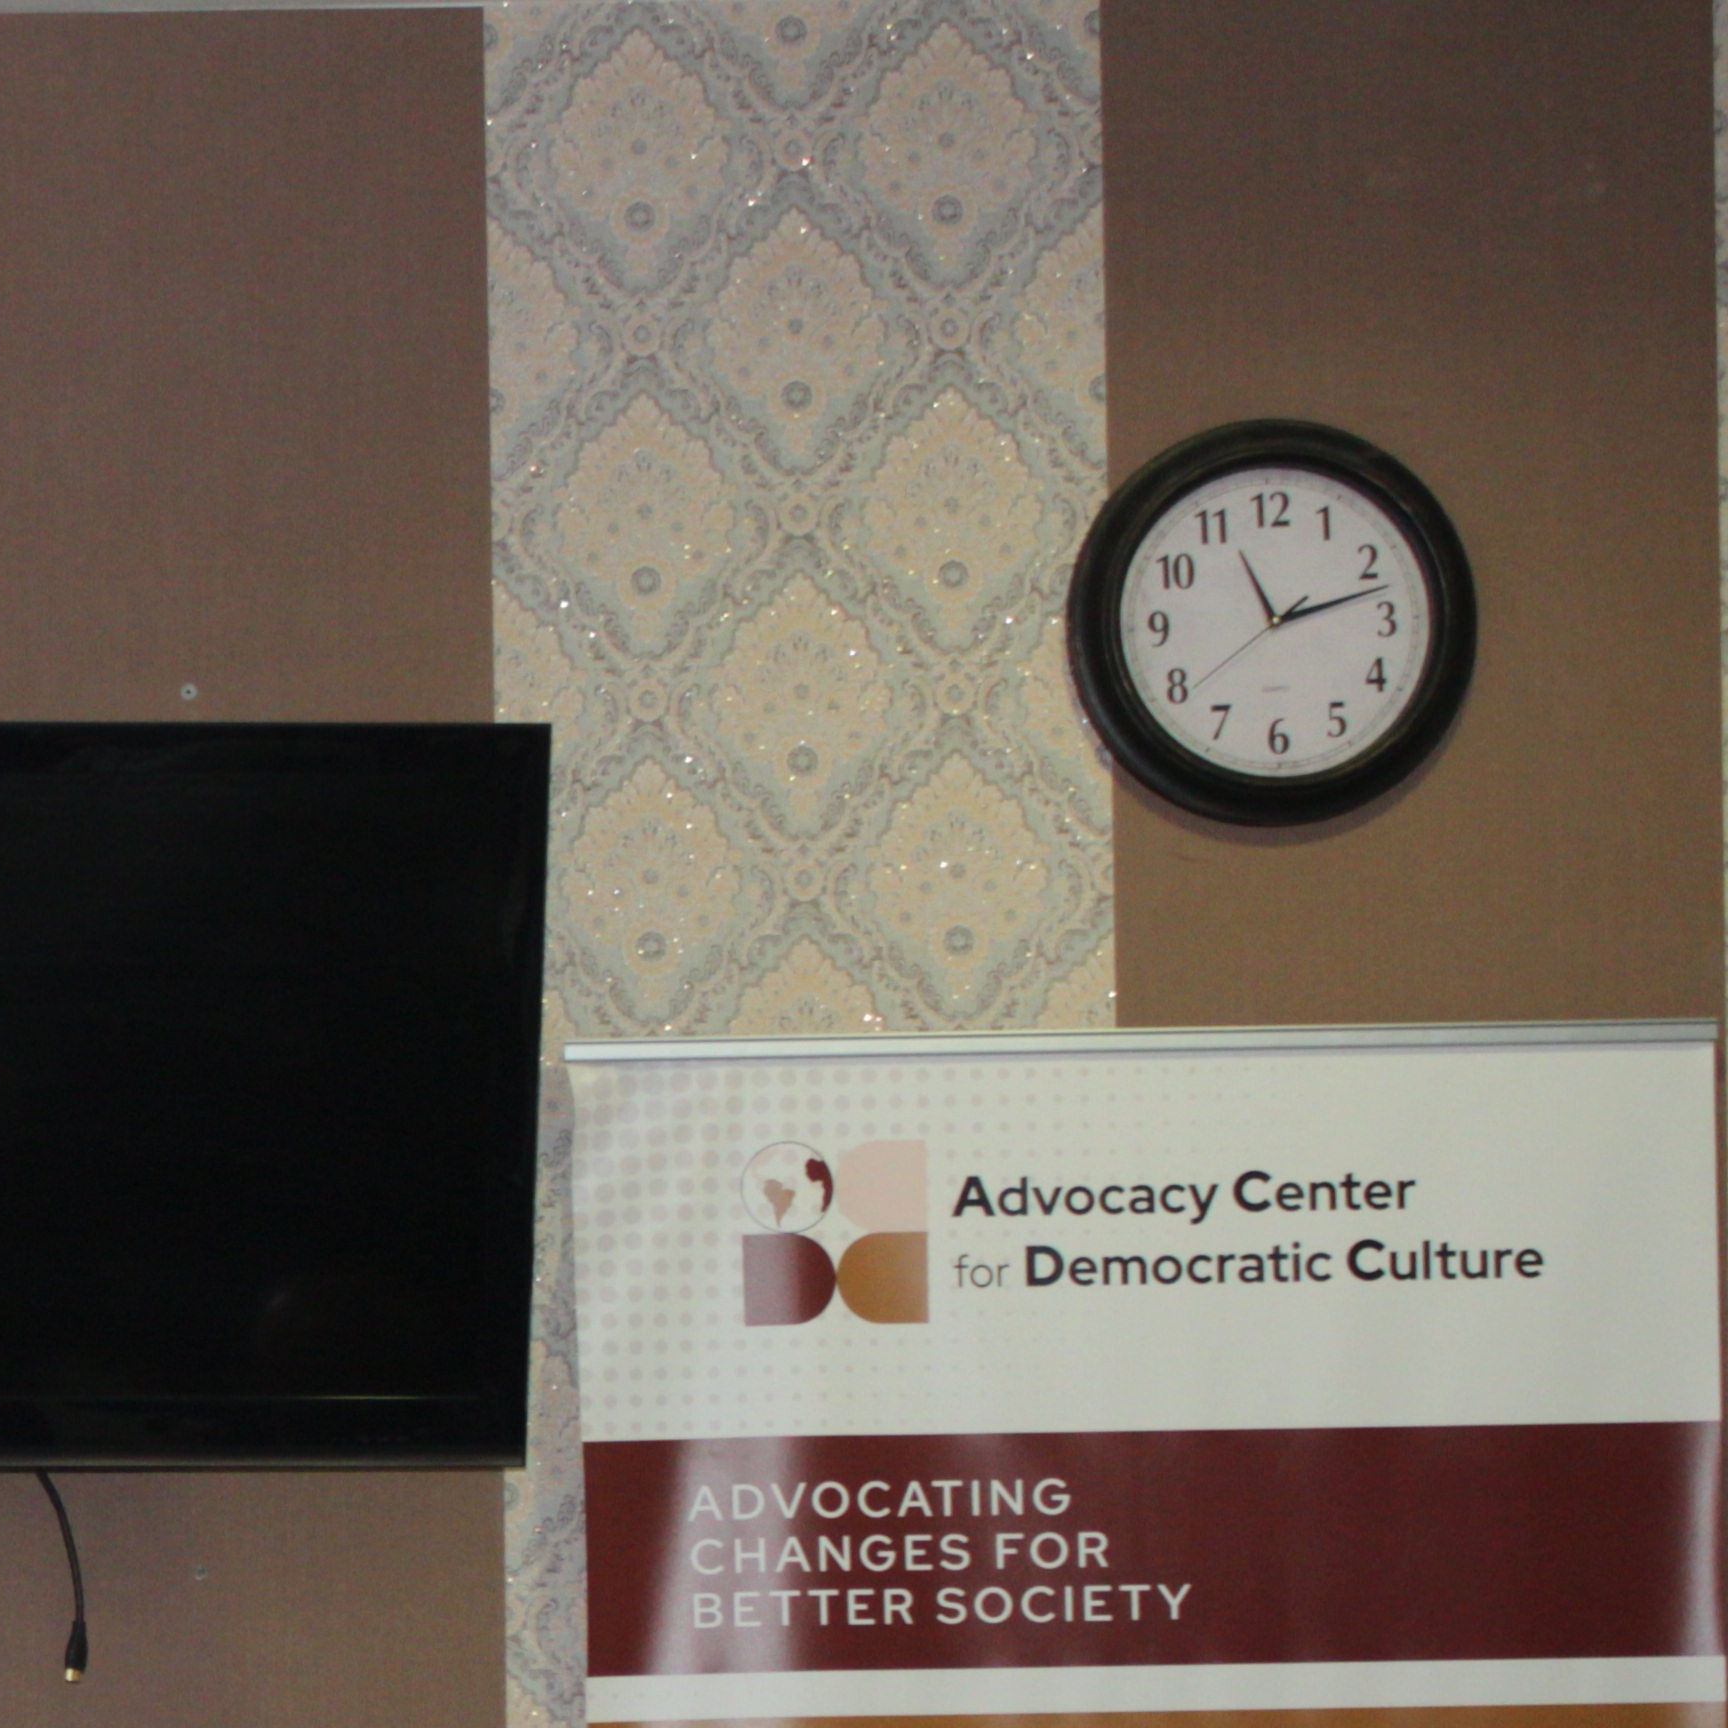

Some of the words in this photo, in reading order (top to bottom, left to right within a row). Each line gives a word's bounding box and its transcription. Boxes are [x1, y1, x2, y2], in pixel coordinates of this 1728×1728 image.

[1195, 509, 1228, 544] 11
[1250, 492, 1290, 528] 12
[1316, 506, 1330, 540] 1
[1156, 553, 1194, 589] 10
[1358, 544, 1378, 580] 2
[1148, 612, 1169, 646] 9
[1377, 602, 1396, 636] 3
[1167, 668, 1188, 703] 8
[1365, 657, 1386, 692] 4
[1211, 704, 1232, 740] 7
[1268, 718, 1289, 754] 6
[1328, 702, 1347, 737] 5
[952, 1176, 1219, 1223] Advocacy
[1232, 1170, 1415, 1214] Center
[955, 1252, 1010, 1289] for
[1025, 1242, 1331, 1287] Democratic
[1346, 1238, 1544, 1281] Culture
[691, 1477, 1072, 1521] ADVOCATING
[691, 1534, 972, 1575] CHANGES
[995, 1531, 1110, 1569] FOR
[693, 1589, 914, 1630] BETTER
[936, 1582, 1192, 1624] SOCIETY
